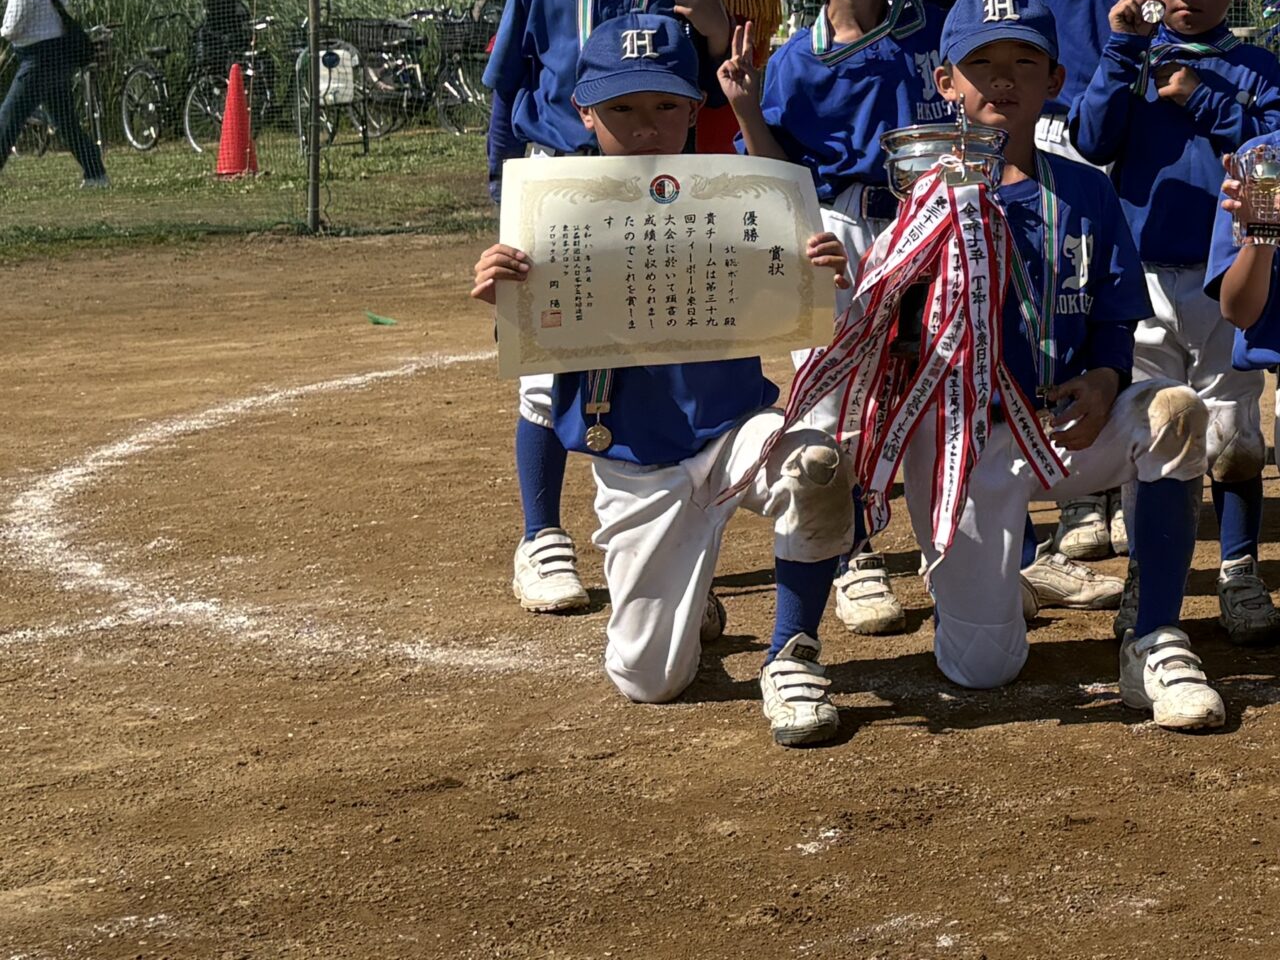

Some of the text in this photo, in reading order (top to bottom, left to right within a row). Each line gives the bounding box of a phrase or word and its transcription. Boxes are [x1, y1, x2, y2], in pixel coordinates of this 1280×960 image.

[621, 29, 660, 61] H
[603, 215, 614, 229] す
[742, 210, 760, 243] 優勝
[767, 245, 785, 276] 賞状
